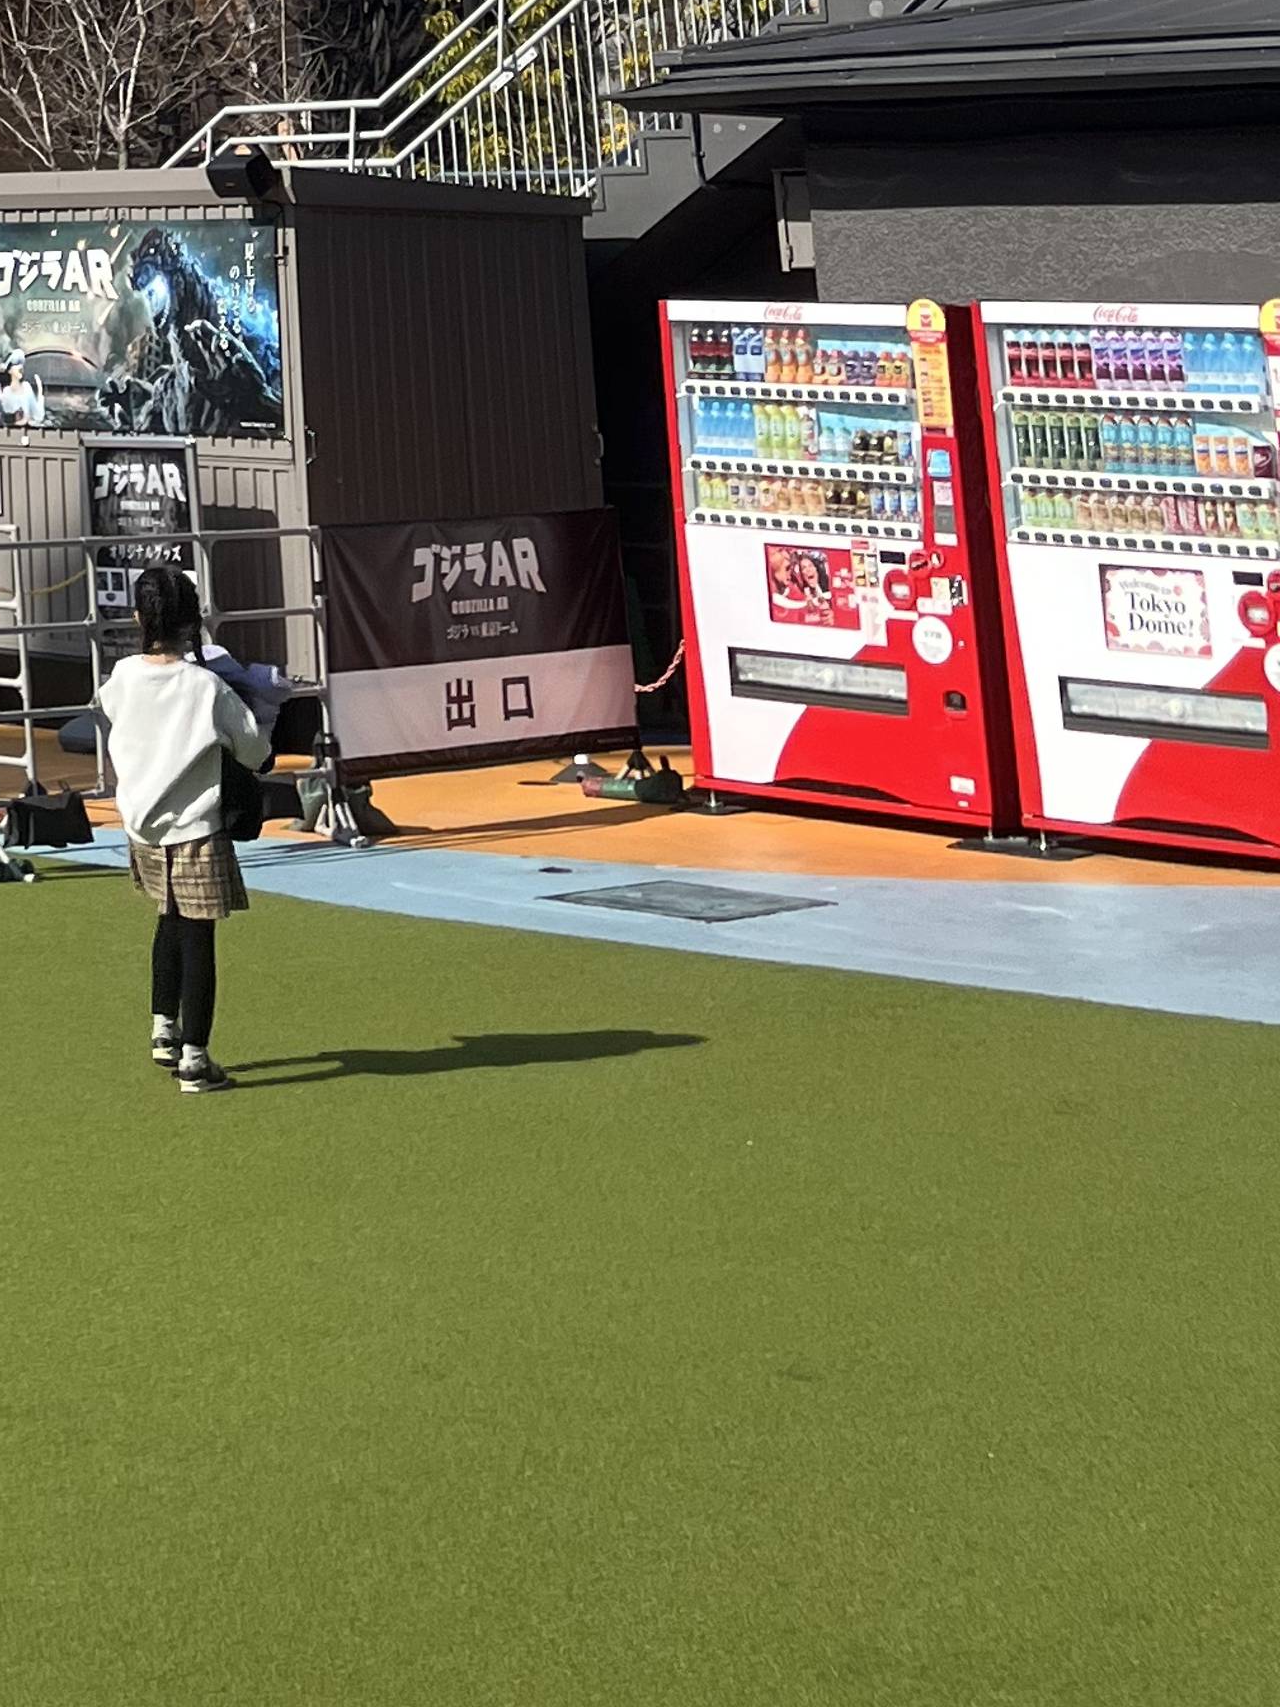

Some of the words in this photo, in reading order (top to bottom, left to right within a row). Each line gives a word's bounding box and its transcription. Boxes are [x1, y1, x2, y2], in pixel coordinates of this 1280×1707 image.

[94, 462, 187, 502] ゴジラAR
[411, 538, 547, 603] ゴジラAR
[1125, 591, 1187, 618] Tokyo
[1129, 612, 1193, 638] Dome!
[446, 676, 534, 732] 出口
